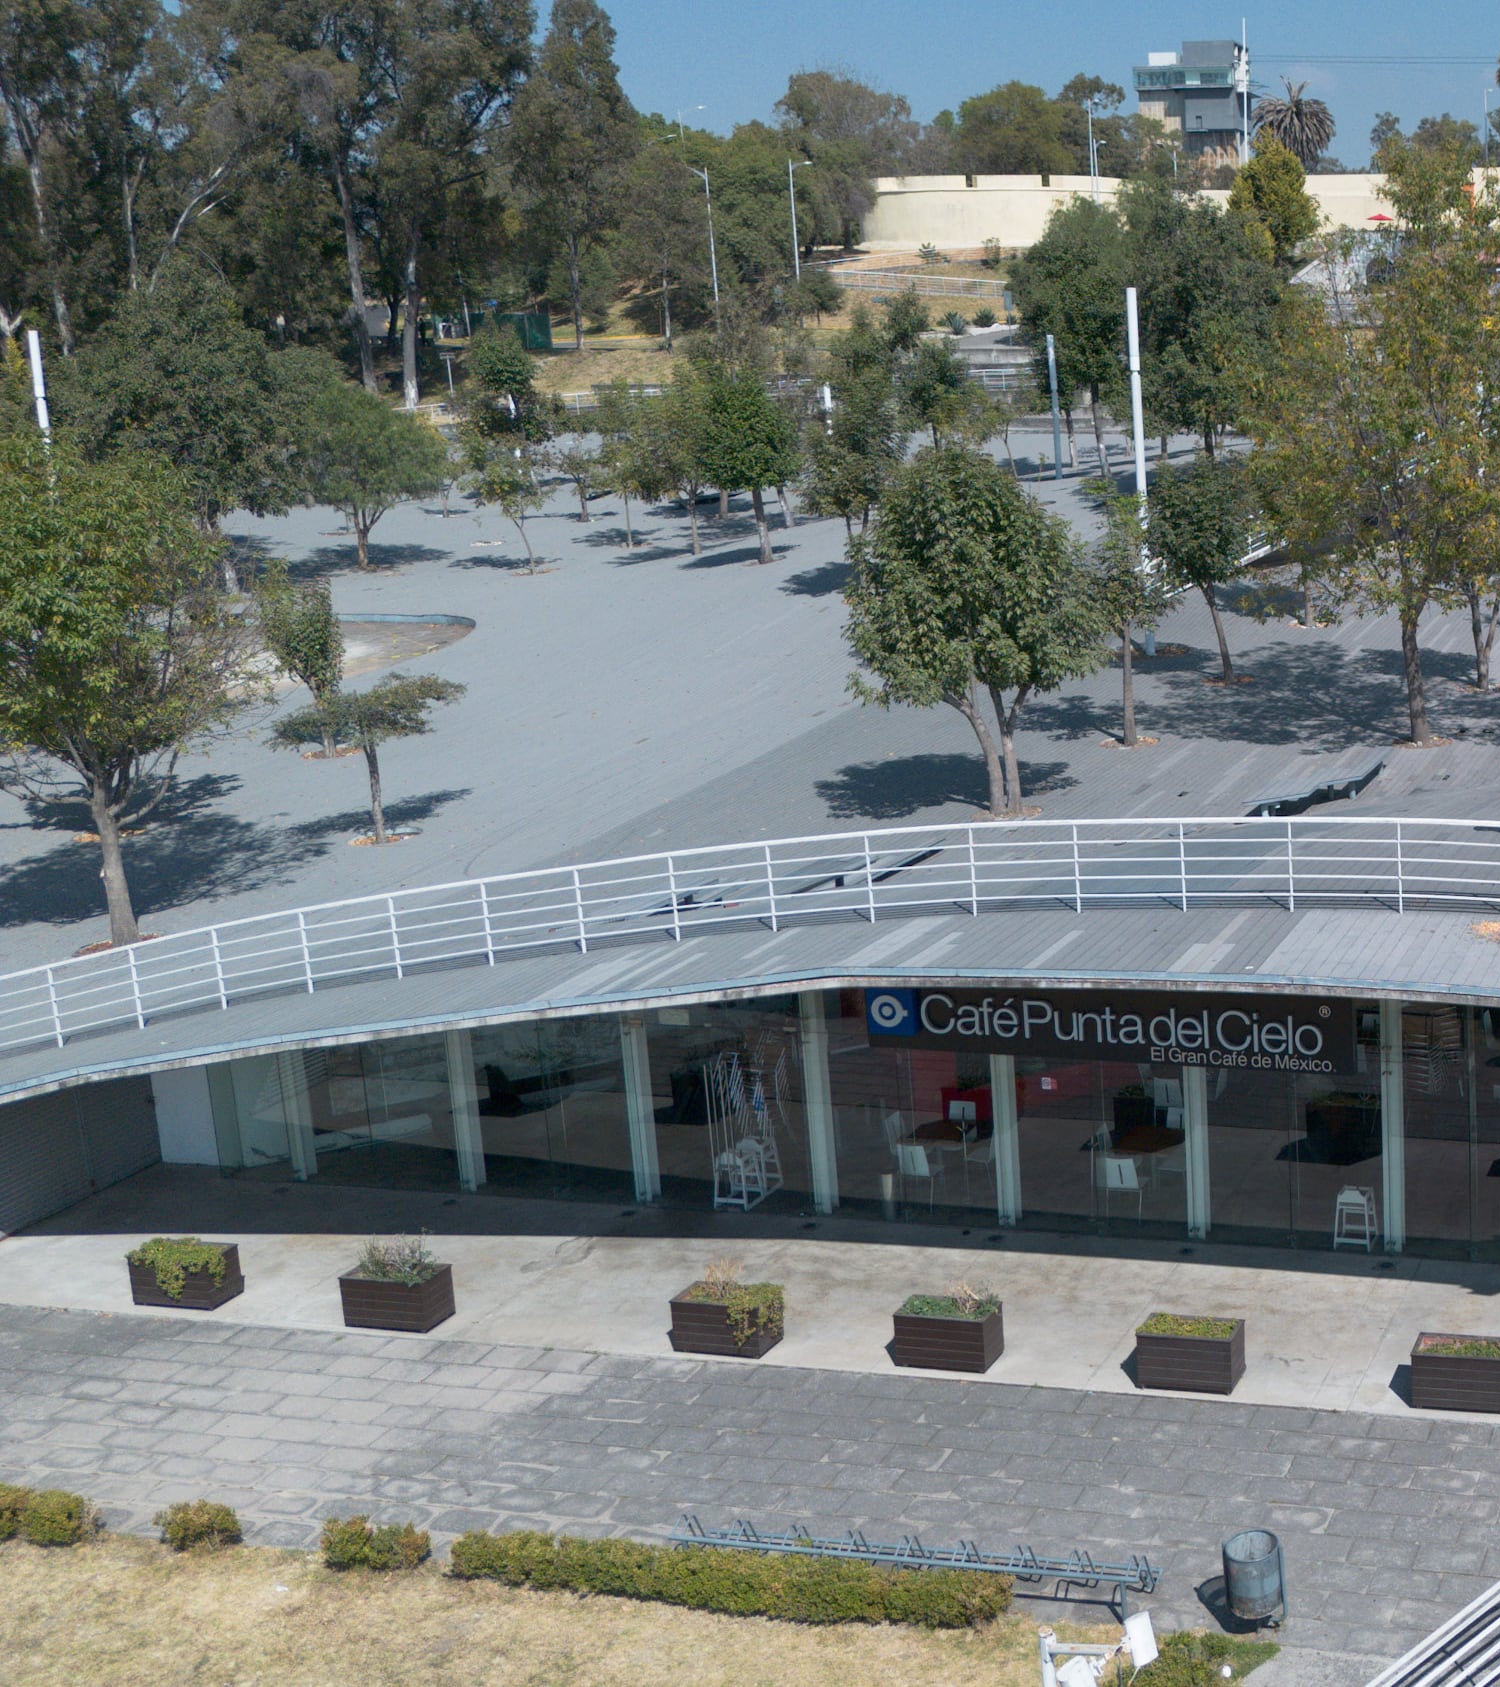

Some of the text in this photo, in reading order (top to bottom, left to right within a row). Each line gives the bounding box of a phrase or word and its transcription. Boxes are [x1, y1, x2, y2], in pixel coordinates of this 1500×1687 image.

[920, 993, 1324, 1056] Café Punta del Cielo
[1150, 1046, 1165, 1063] El
[1168, 1048, 1208, 1065] Gran
[1208, 1050, 1249, 1067] Café
[1250, 1053, 1273, 1070] de
